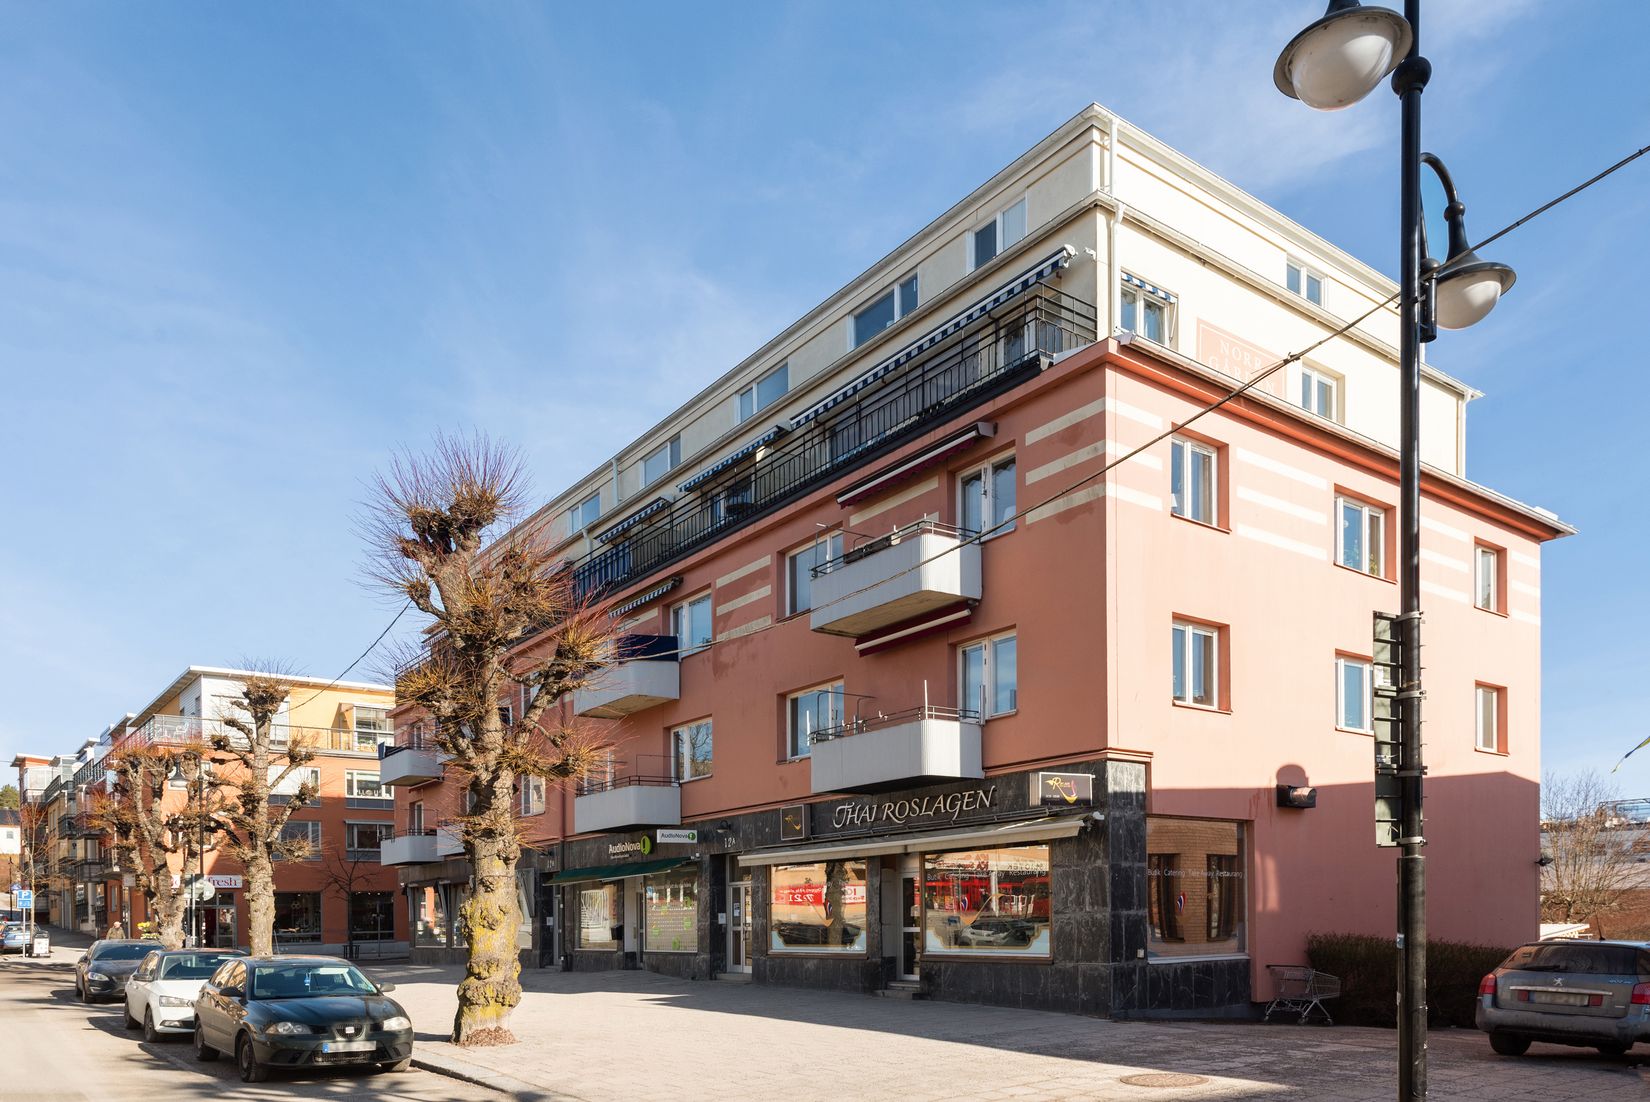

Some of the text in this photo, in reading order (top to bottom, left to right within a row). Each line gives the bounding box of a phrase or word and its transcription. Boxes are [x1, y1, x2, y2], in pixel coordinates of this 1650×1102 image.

[833, 785, 997, 829] THAI ROSLAGEN
[608, 842, 641, 854] AudioNova
[1163, 868, 1185, 878] Catering
[1215, 869, 1243, 879] Restaurang
[207, 876, 238, 887] fresh
[22, 891, 30, 899] P
